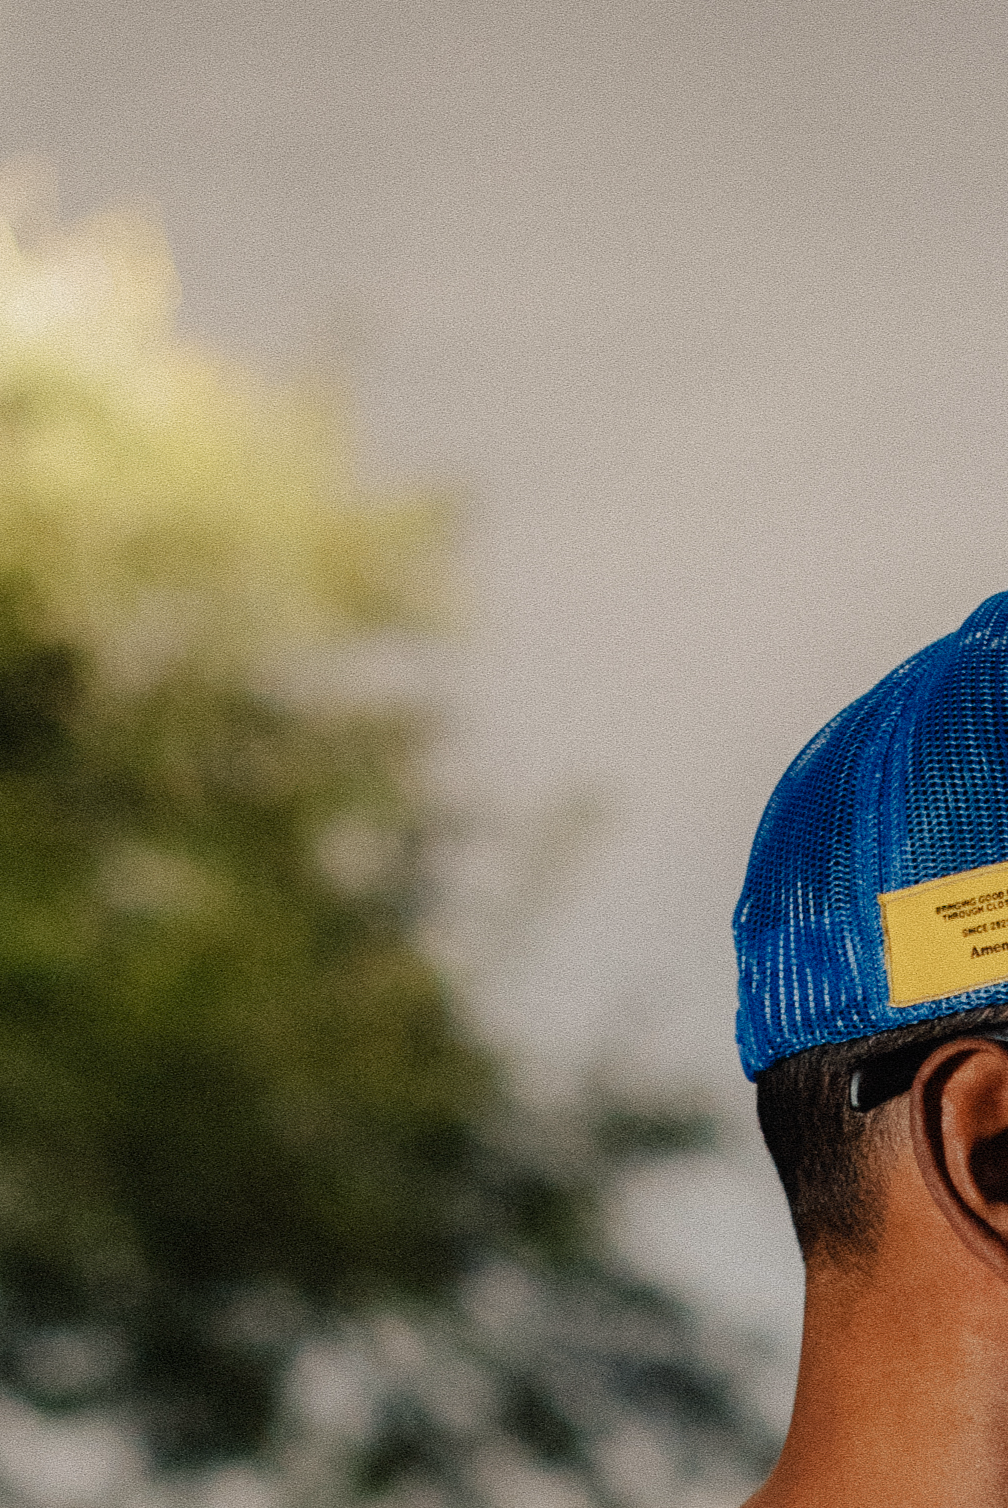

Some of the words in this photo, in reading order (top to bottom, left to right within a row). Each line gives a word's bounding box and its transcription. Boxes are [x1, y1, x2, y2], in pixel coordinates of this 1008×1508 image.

[978, 890, 1005, 904] GOOD
[942, 906, 984, 922] THROUGH
[962, 923, 988, 938] SINCE
